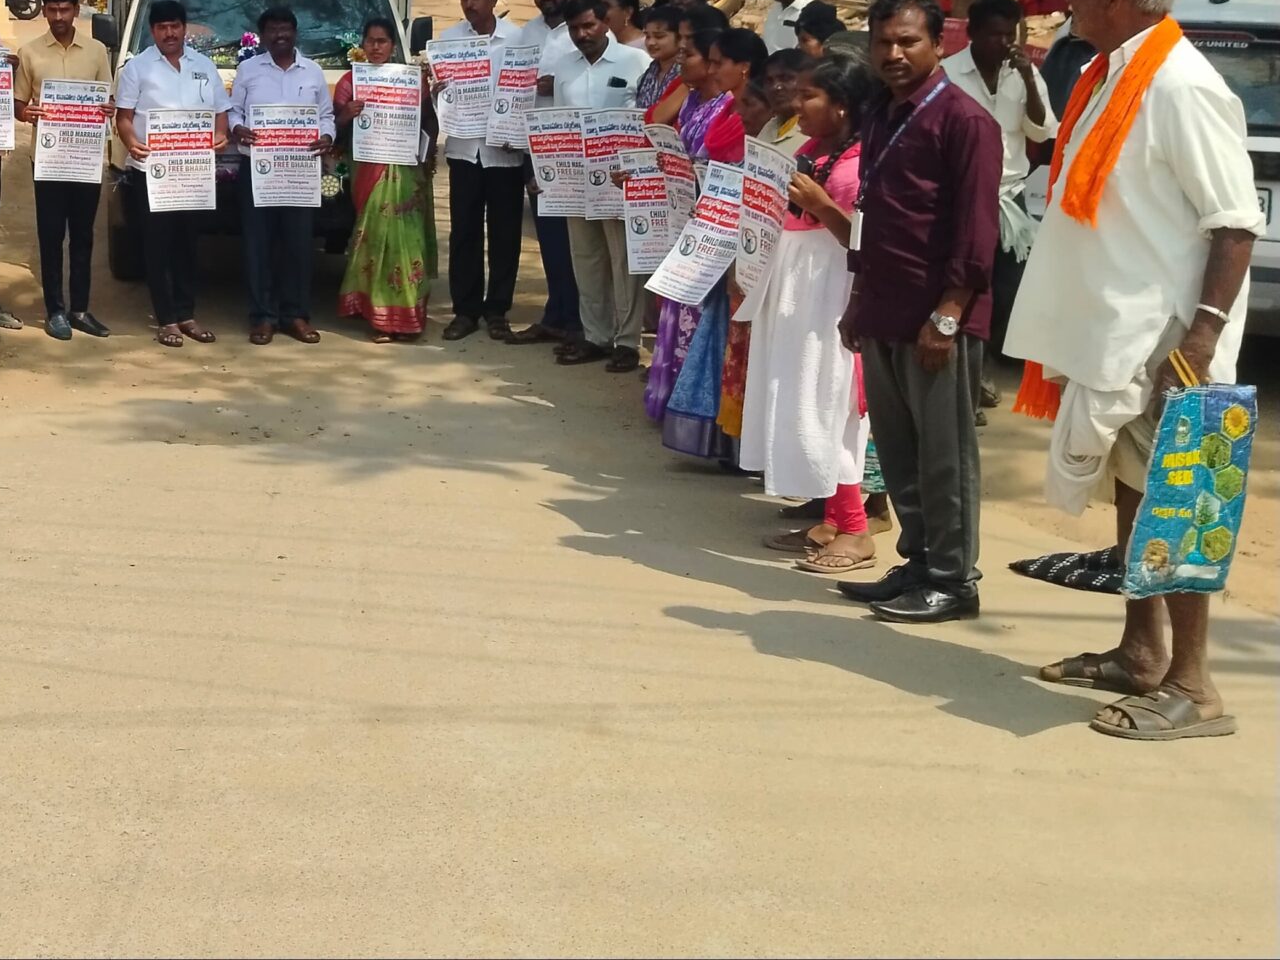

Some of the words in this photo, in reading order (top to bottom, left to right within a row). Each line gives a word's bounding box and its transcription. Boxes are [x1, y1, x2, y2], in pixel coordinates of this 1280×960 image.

[463, 85, 490, 94] MARRIAGE
[702, 235, 718, 246] CHILD
[697, 244, 715, 256] FREE
